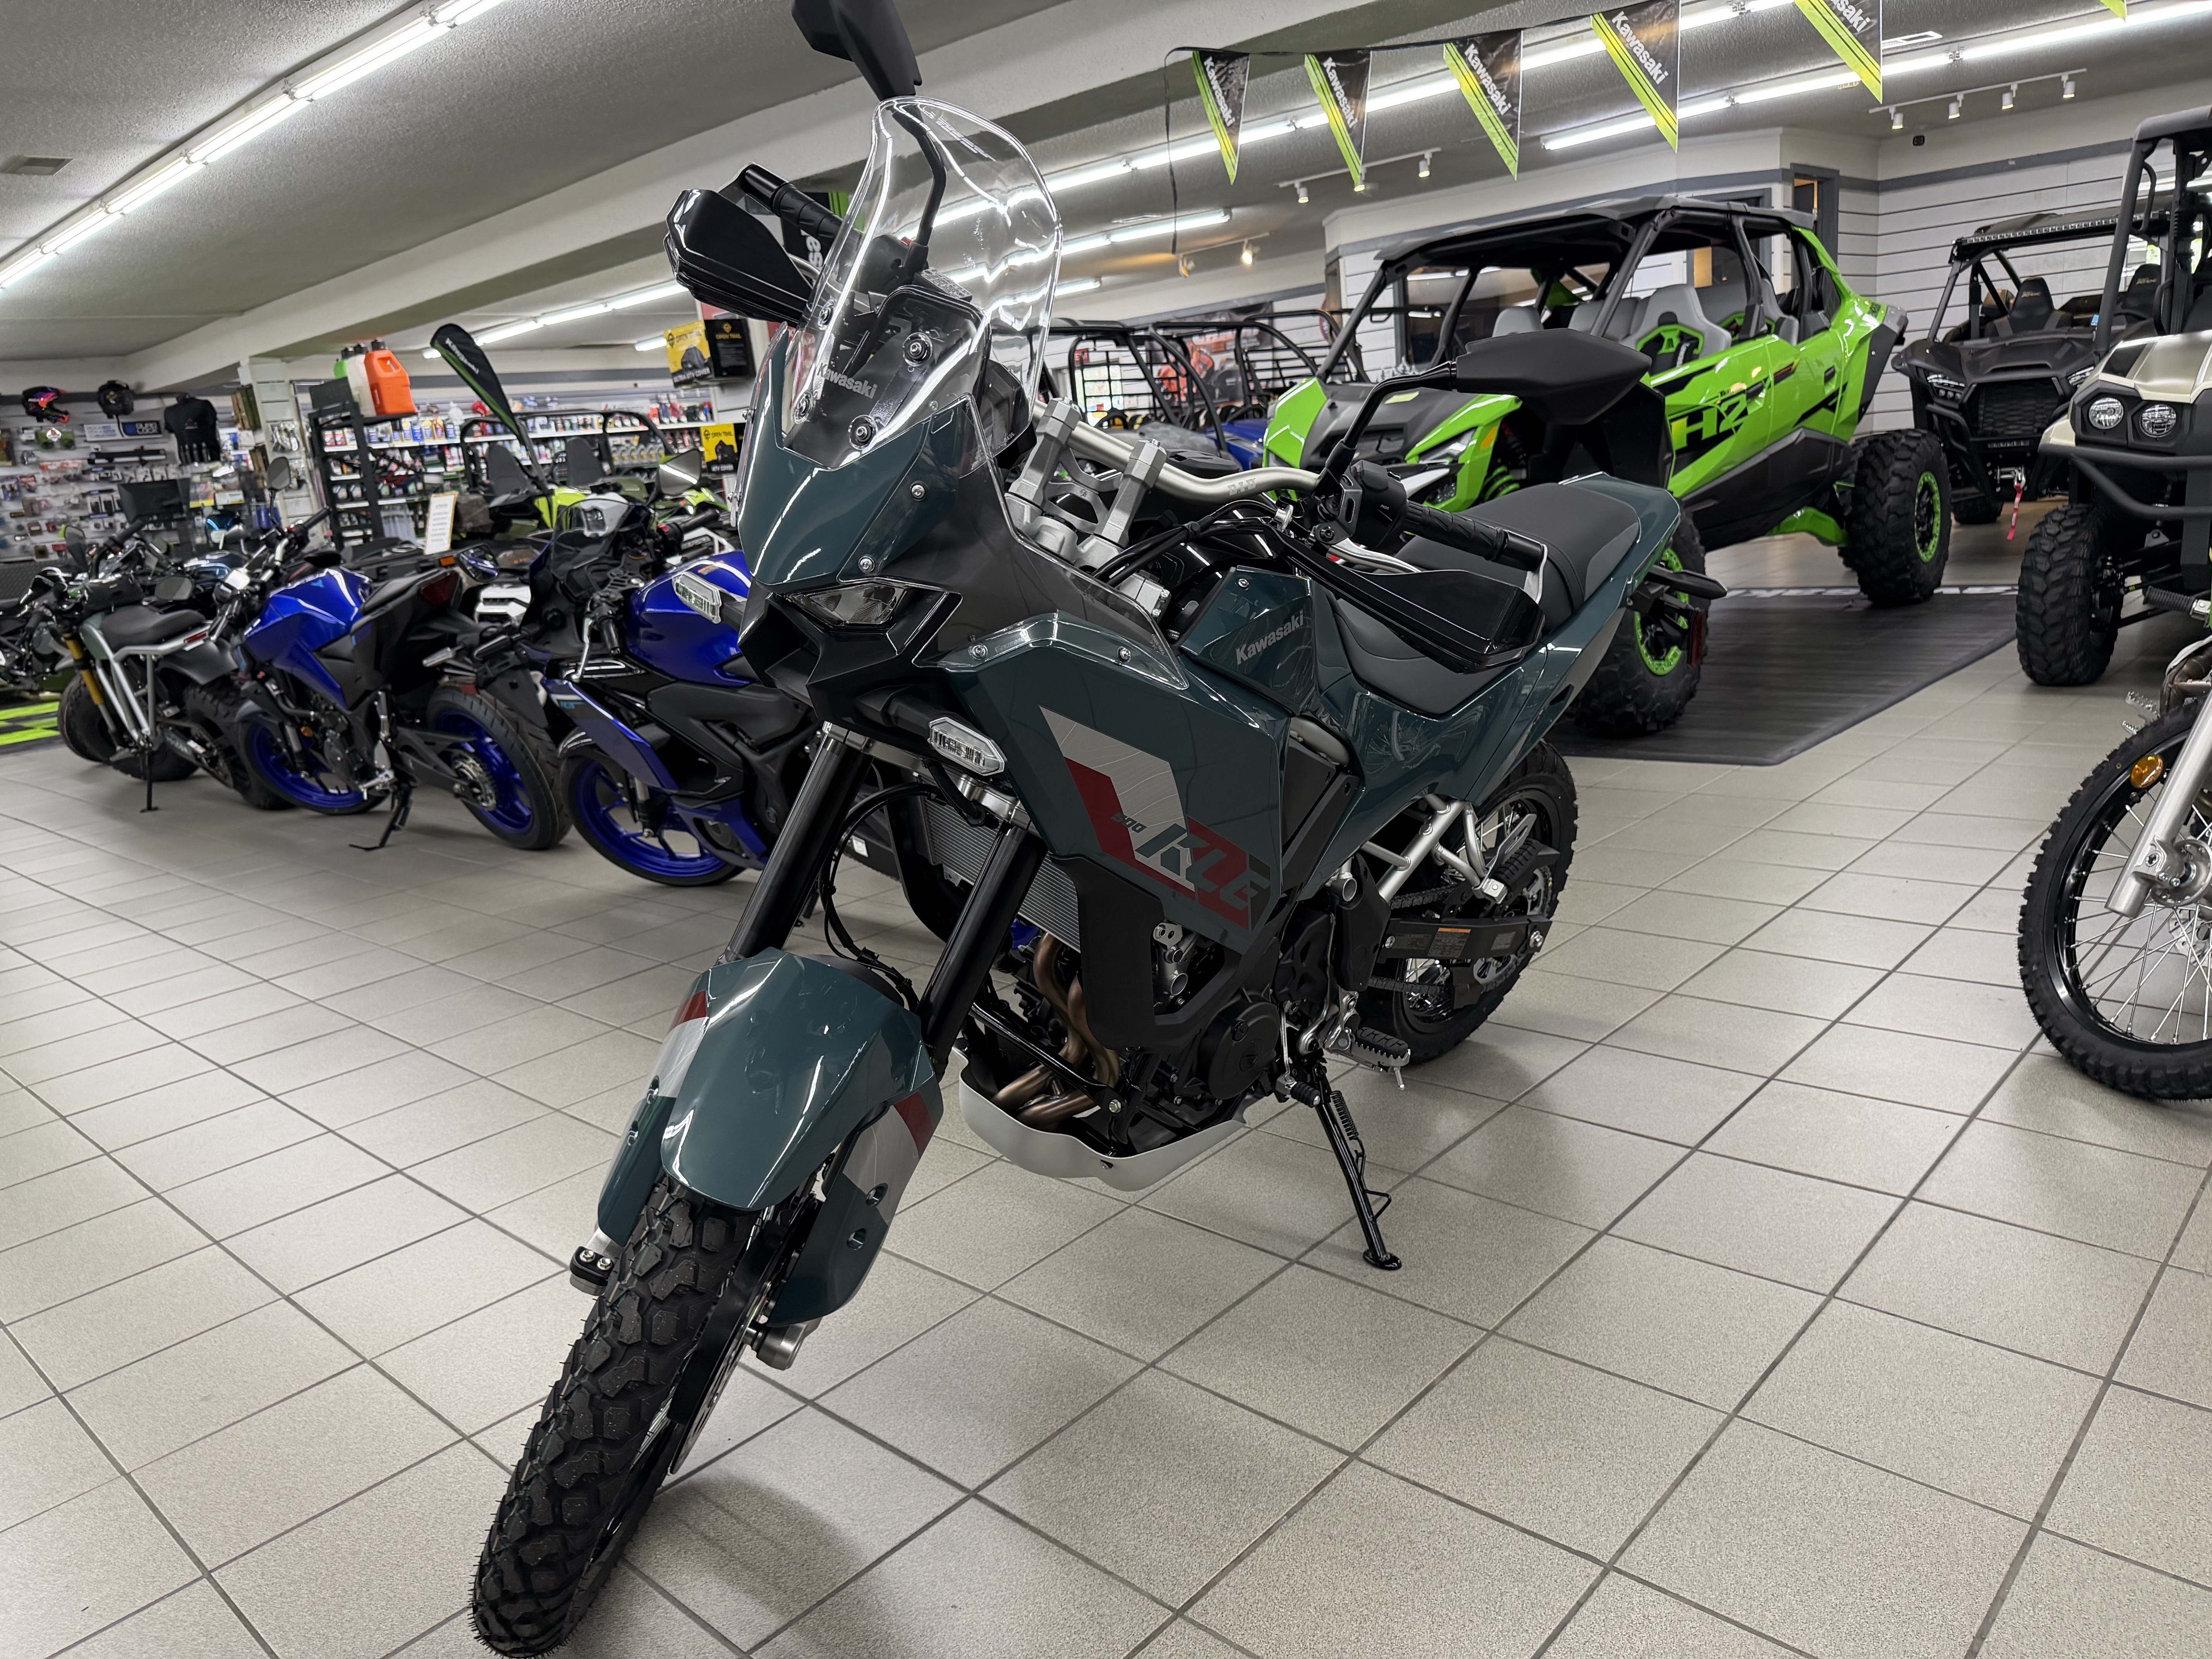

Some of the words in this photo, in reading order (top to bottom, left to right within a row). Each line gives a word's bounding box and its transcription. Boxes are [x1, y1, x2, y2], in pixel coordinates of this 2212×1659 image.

[1464, 43, 1512, 115] Kawasaki
[1612, 11, 1669, 85] Kawasaki
[1204, 56, 1235, 127] Kawasaki
[1323, 57, 1358, 129] Kawasaki
[446, 338, 479, 374] Kawasaki
[817, 362, 878, 399] Kawasaki
[1671, 393, 1749, 451] H2
[1236, 610, 1304, 665] Kawasaki
[1111, 812, 1147, 833] 500
[1134, 823, 1271, 910] KLE
